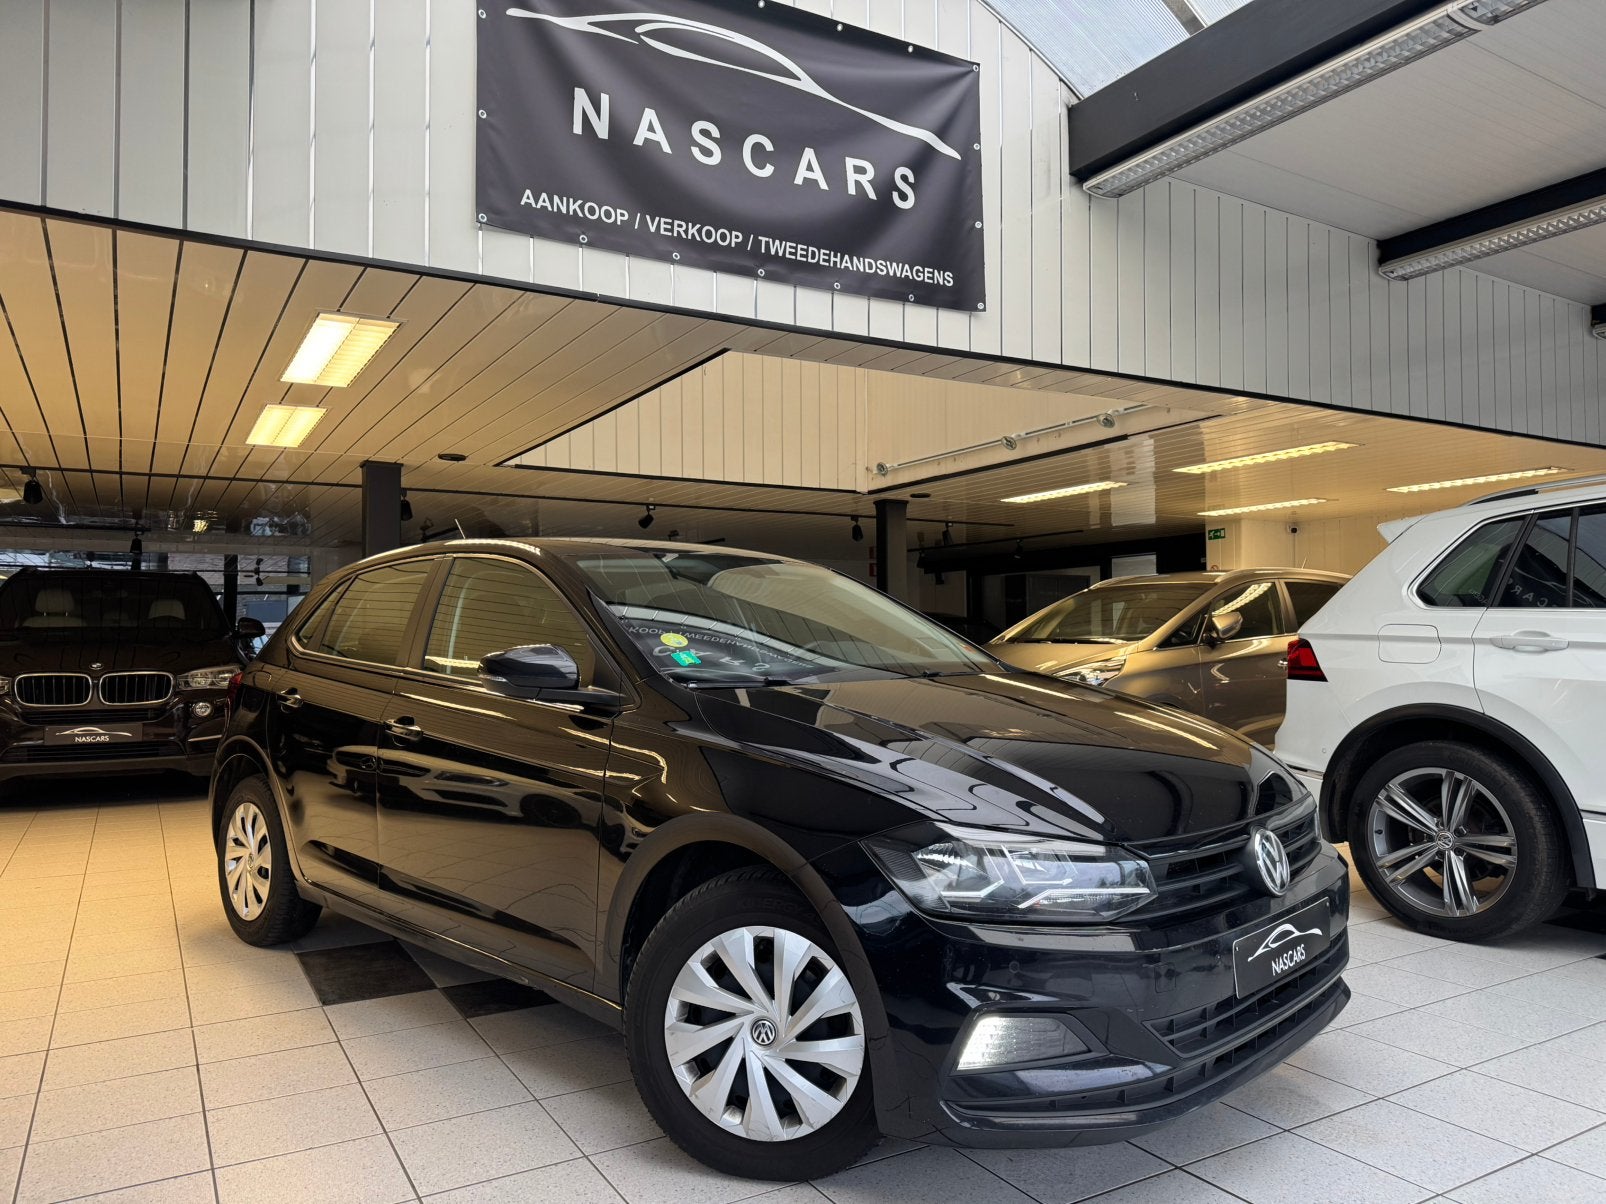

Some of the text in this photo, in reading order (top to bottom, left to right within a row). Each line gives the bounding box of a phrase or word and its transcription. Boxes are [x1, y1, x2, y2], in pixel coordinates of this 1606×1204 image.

[572, 87, 916, 210] NASCARS
[520, 189, 954, 287] AANKOOP / VERKOOP / TWEEDEHANDSWAGENS
[75, 735, 110, 743] NASCARS
[1271, 943, 1306, 976] NASCARS
